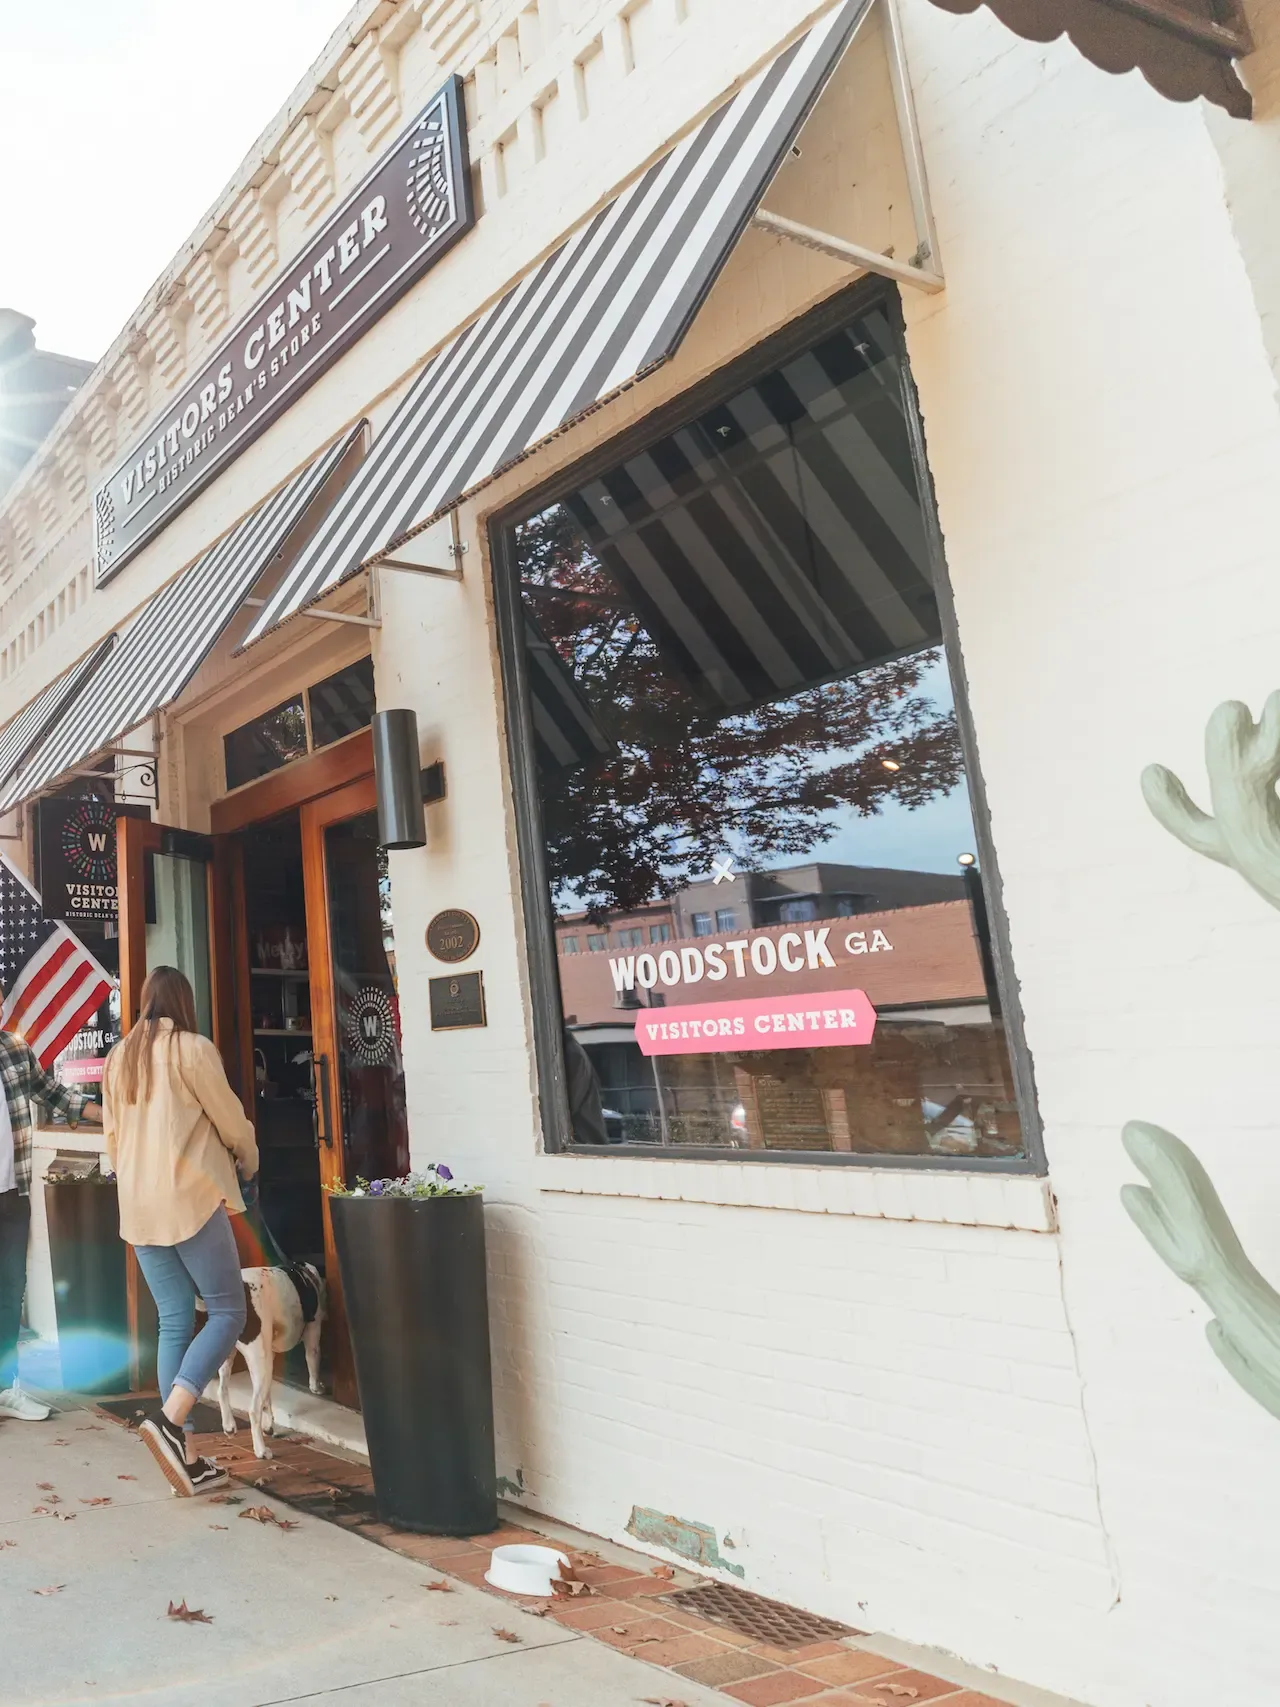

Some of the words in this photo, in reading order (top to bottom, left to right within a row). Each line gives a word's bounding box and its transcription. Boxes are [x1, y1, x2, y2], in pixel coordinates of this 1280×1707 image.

[121, 362, 232, 504] VISITORS
[244, 195, 388, 370] CENTER
[158, 424, 215, 494] HISTORIC
[219, 369, 267, 432] DEAN'S
[271, 312, 322, 377] STORE
[88, 833, 106, 852] W
[65, 884, 118, 897] VISITO
[71, 897, 118, 910] CENTE
[439, 936, 463, 950] 2002
[608, 927, 837, 992] WOODSTOCK
[845, 929, 894, 955] GA
[363, 1015, 379, 1038] W
[646, 1017, 745, 1042] VISITORS
[754, 1008, 857, 1034] CENTER
[104, 1033, 115, 1043] GA
[86, 1065, 104, 1076] CENT
